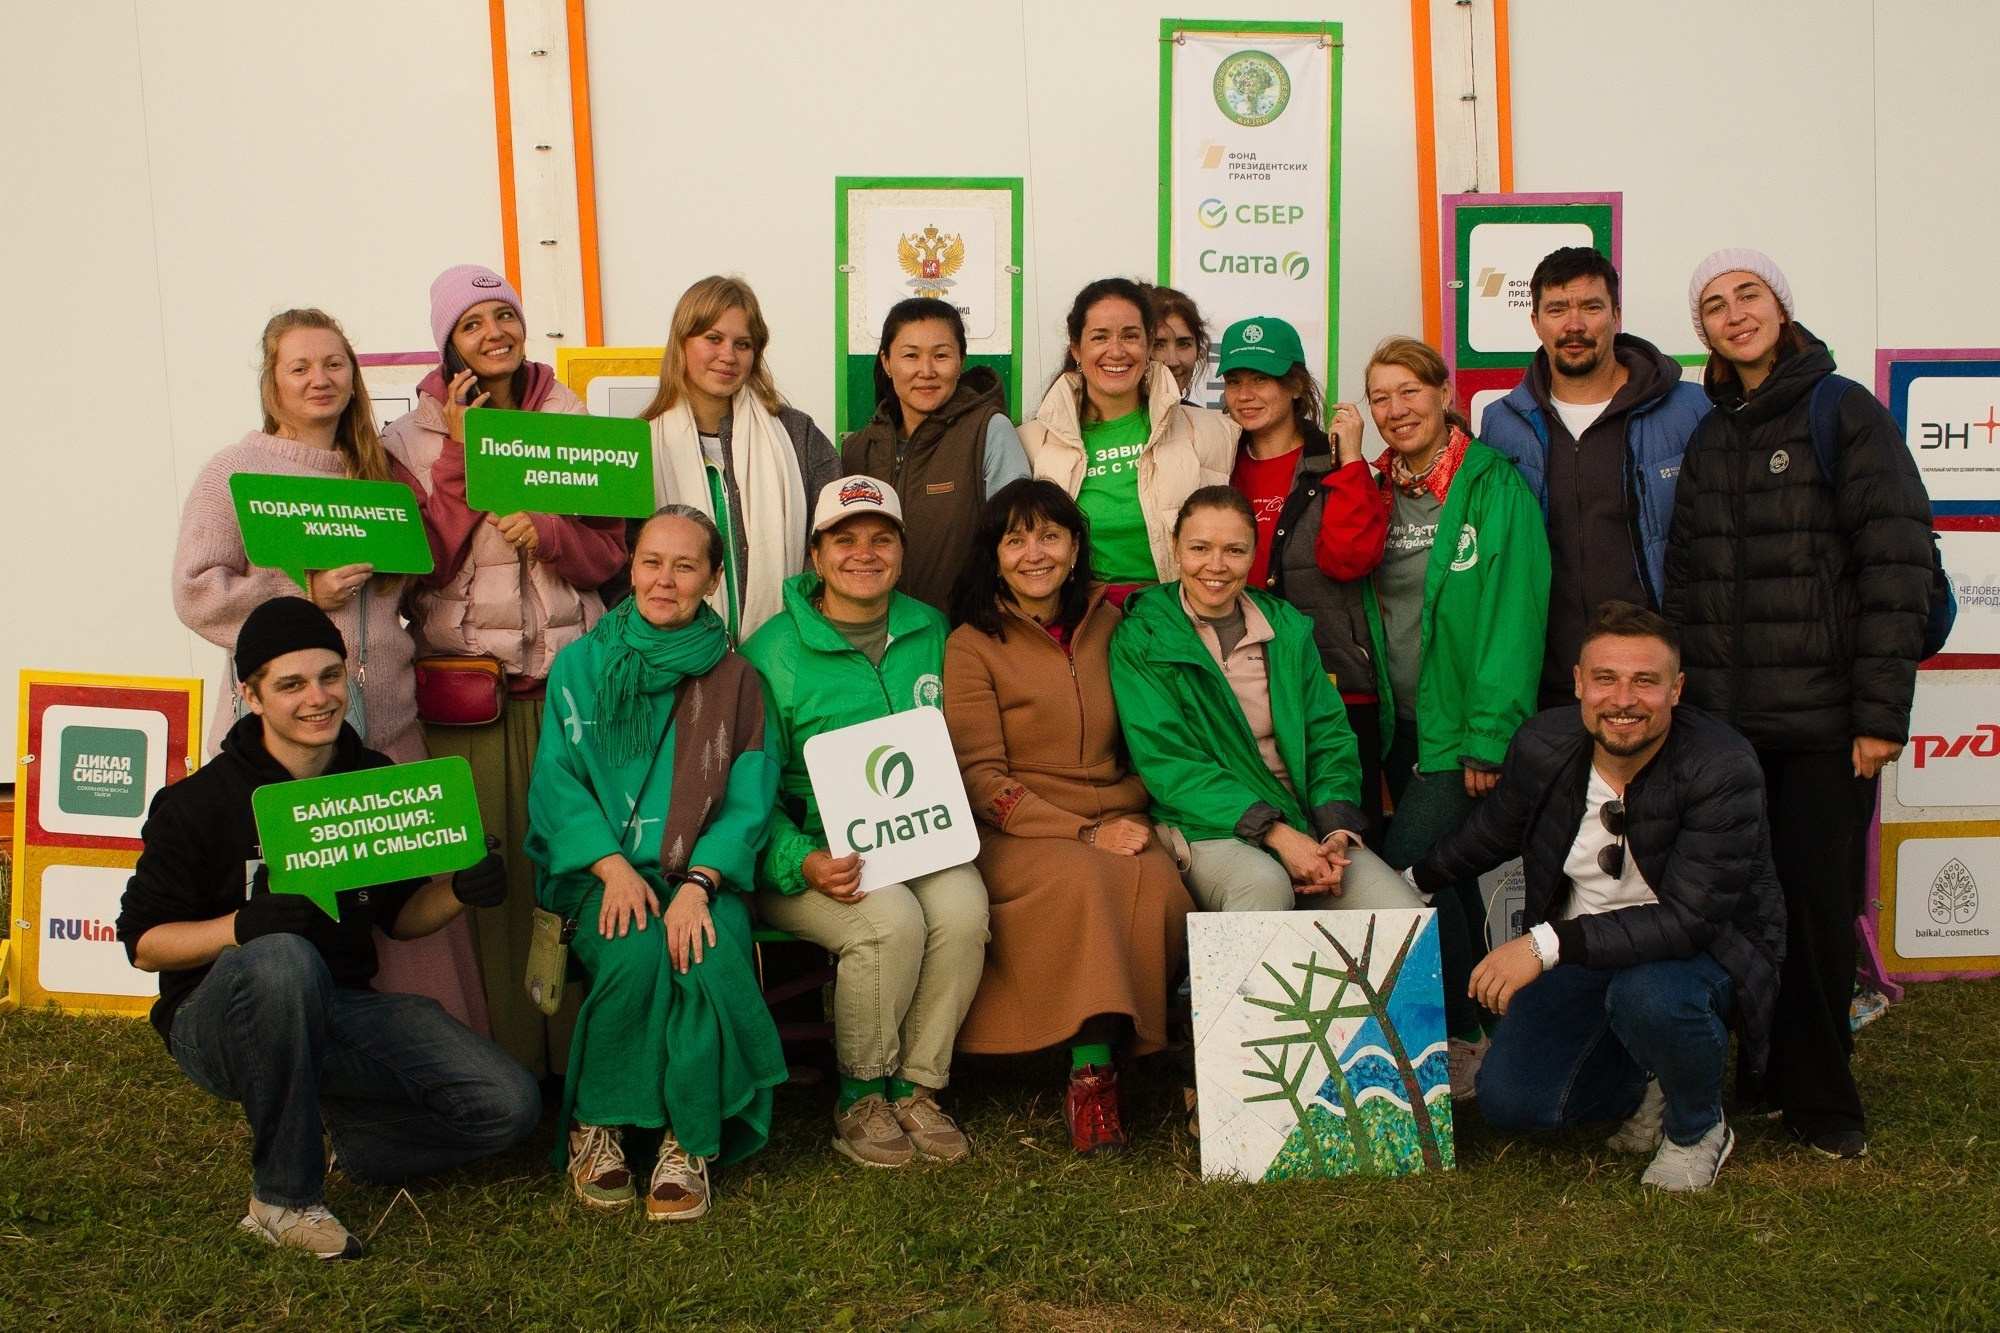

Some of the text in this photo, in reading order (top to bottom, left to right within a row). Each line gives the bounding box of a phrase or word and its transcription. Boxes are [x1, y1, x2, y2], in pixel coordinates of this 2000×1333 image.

[1235, 115, 1269, 126] ЖИЗНЬ
[1228, 152, 1256, 160] ФОНД
[1228, 162, 1308, 171] ПРЕЗИДЕНТСКИХ
[1235, 204, 1304, 225] СБЕР
[1199, 249, 1277, 274] Слата
[480, 437, 639, 469] Любим природу
[1096, 444, 1144, 461] зави
[524, 469, 599, 487] делами
[1087, 465, 1106, 477] ас
[249, 500, 408, 522] ПОДАРИ ПЛАНЕТЕ
[303, 521, 367, 538] ЖИЗНЬ
[1959, 596, 2000, 607] ПРИРОД
[75, 753, 131, 771] ДИКАЯ
[73, 768, 133, 785] СИБИРЬ
[292, 784, 443, 823] БАЙКАЛЬСКАЯ
[309, 809, 435, 843] ЭВОЛЮЦИЯ:
[846, 804, 953, 853] Слата
[285, 826, 467, 872] ЛЮДИ И СМЫСЛЫ
[50, 917, 119, 942] RULin
[1915, 928, 1989, 938] baikal_cosmetics
